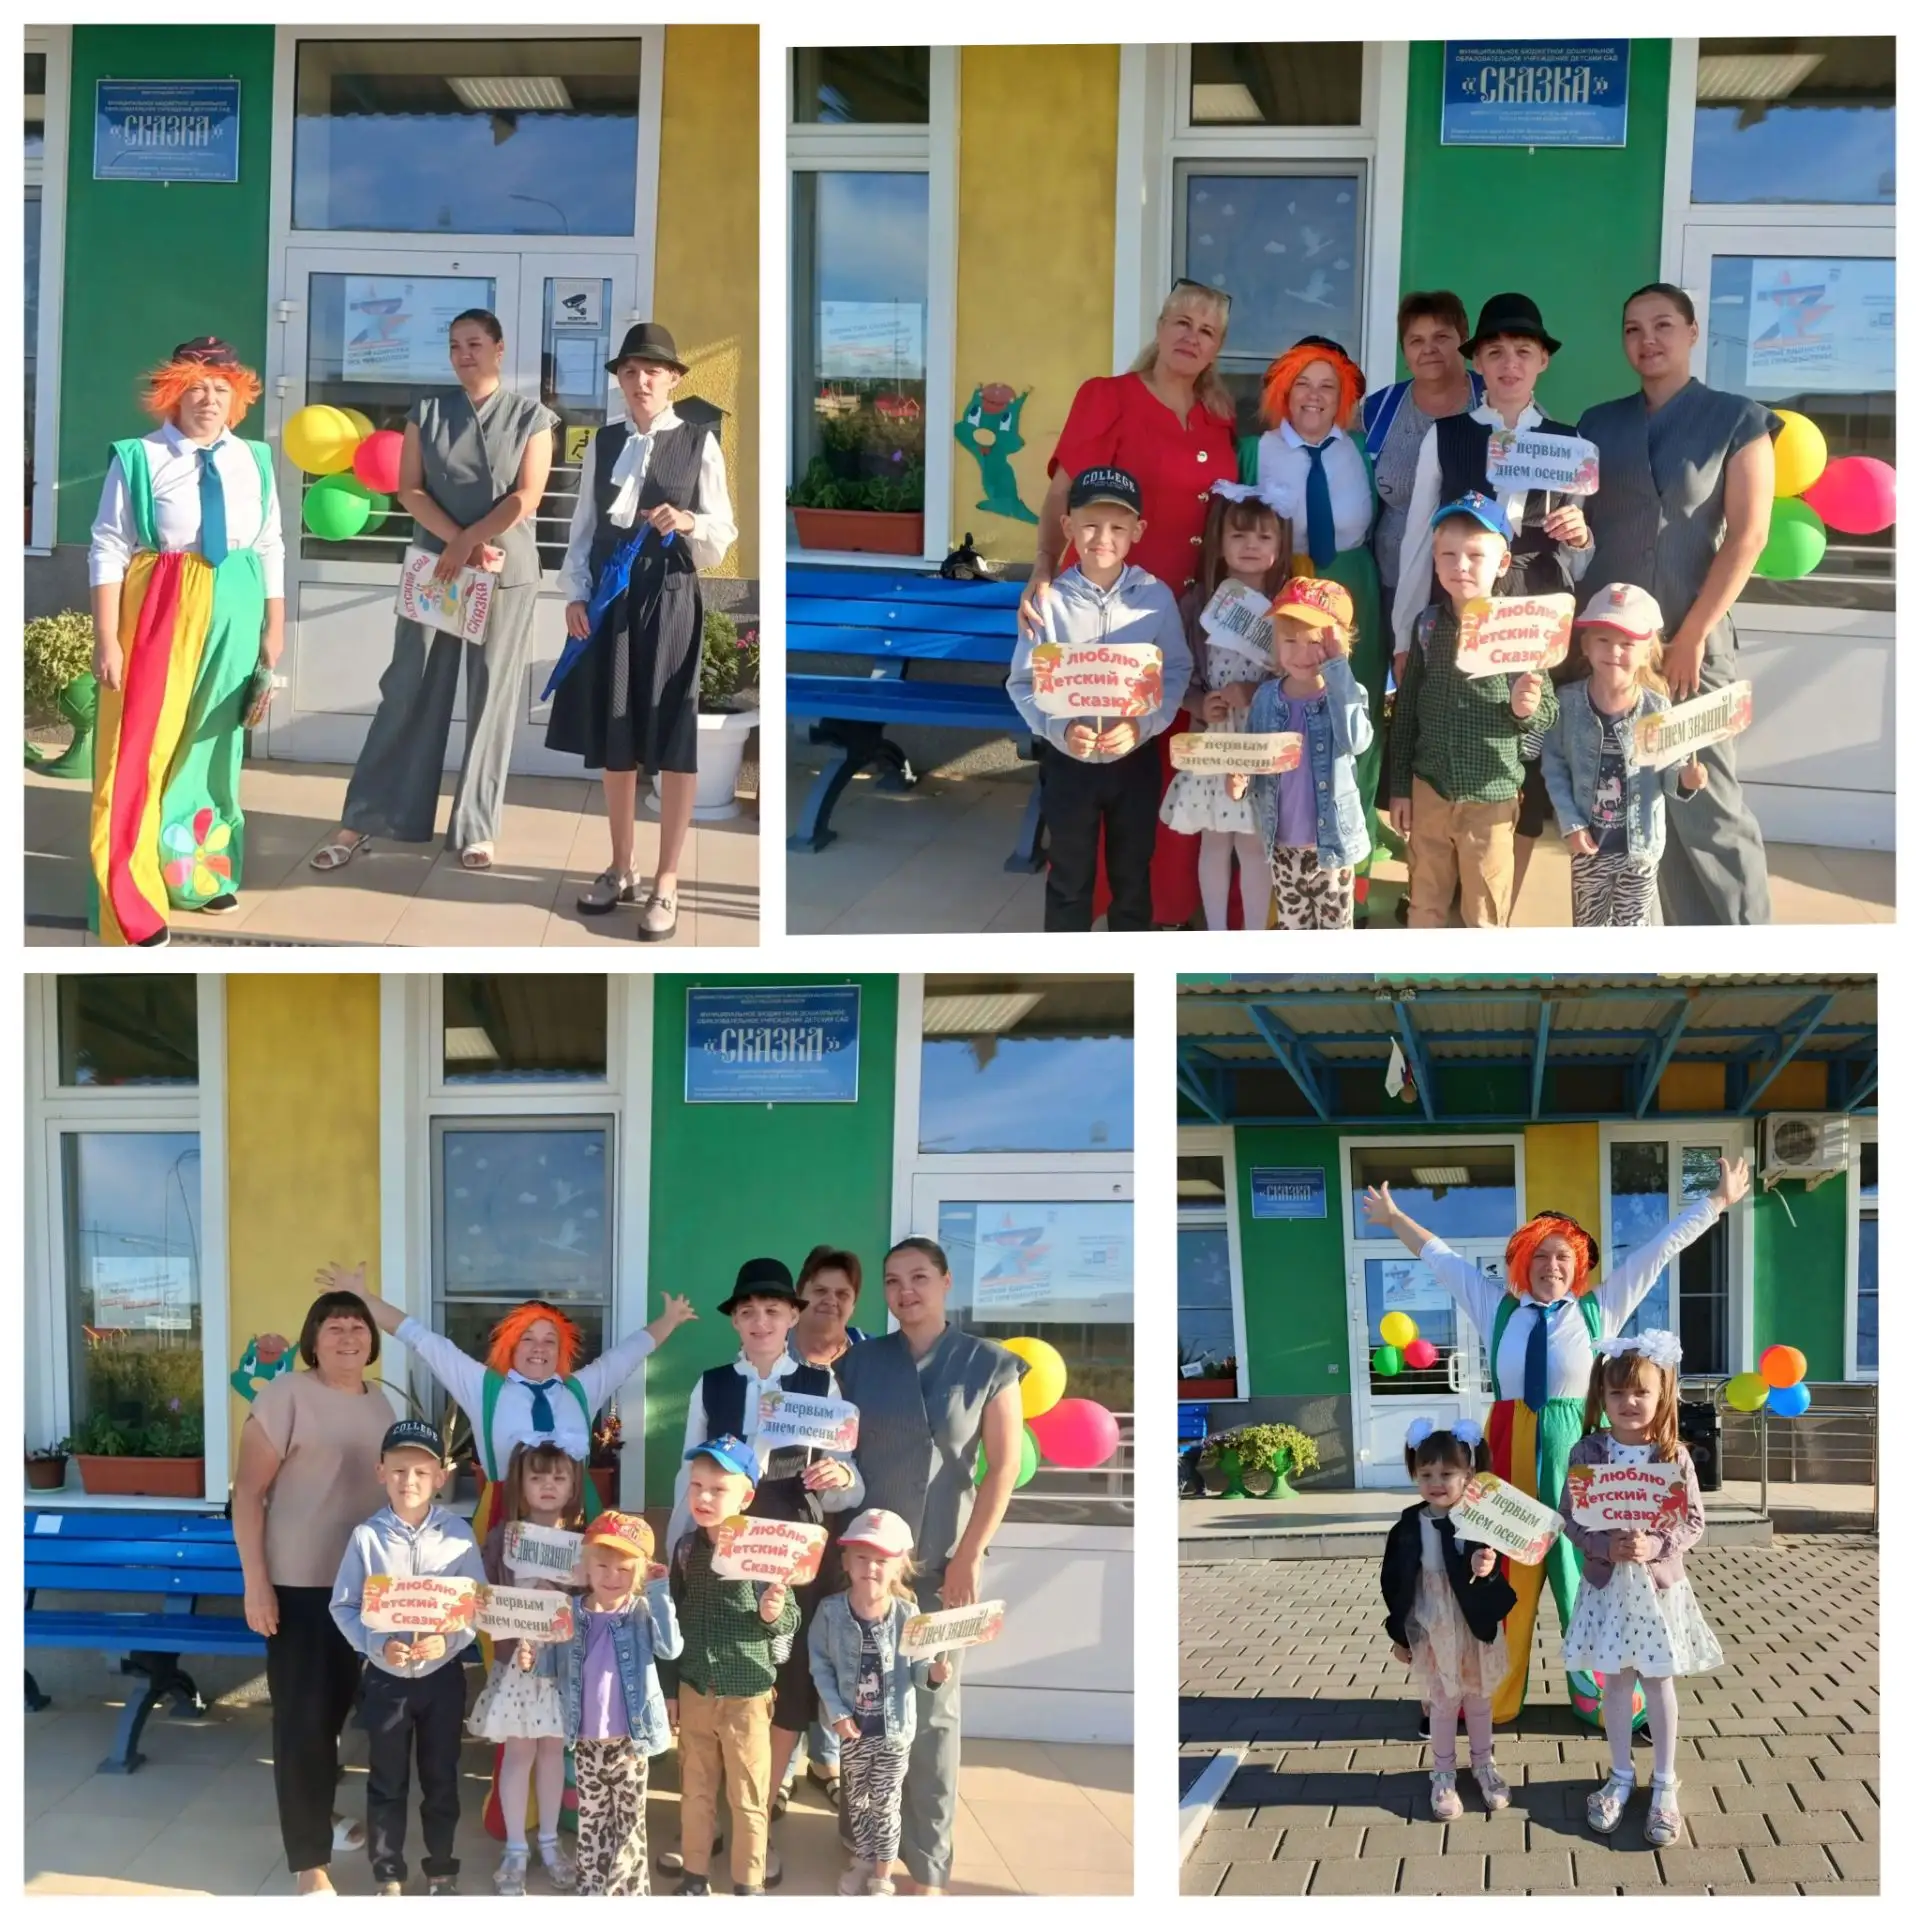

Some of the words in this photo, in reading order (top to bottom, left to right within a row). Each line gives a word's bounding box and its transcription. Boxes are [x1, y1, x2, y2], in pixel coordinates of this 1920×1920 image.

[1516, 441, 1571, 459] первым
[1083, 470, 1136, 493] COLLEGE
[1535, 465, 1578, 482] осени!
[467, 582, 488, 634] СКАЗКА
[1495, 601, 1558, 620] люблю
[1067, 648, 1139, 668] люблю
[1204, 740, 1269, 753] первым
[784, 1401, 833, 1419] первым
[799, 1425, 838, 1440] осени!
[1599, 1467, 1666, 1486] люблю
[1577, 1488, 1647, 1509] Детский
[1491, 1493, 1541, 1529] первым
[1602, 1508, 1662, 1528] Сказку
[748, 1523, 808, 1544] люблю
[1460, 1506, 1494, 1530] днем
[1494, 1524, 1534, 1550] осени!
[395, 1578, 457, 1596] люблю
[495, 1596, 544, 1611] первым
[514, 1618, 553, 1632] осени!
